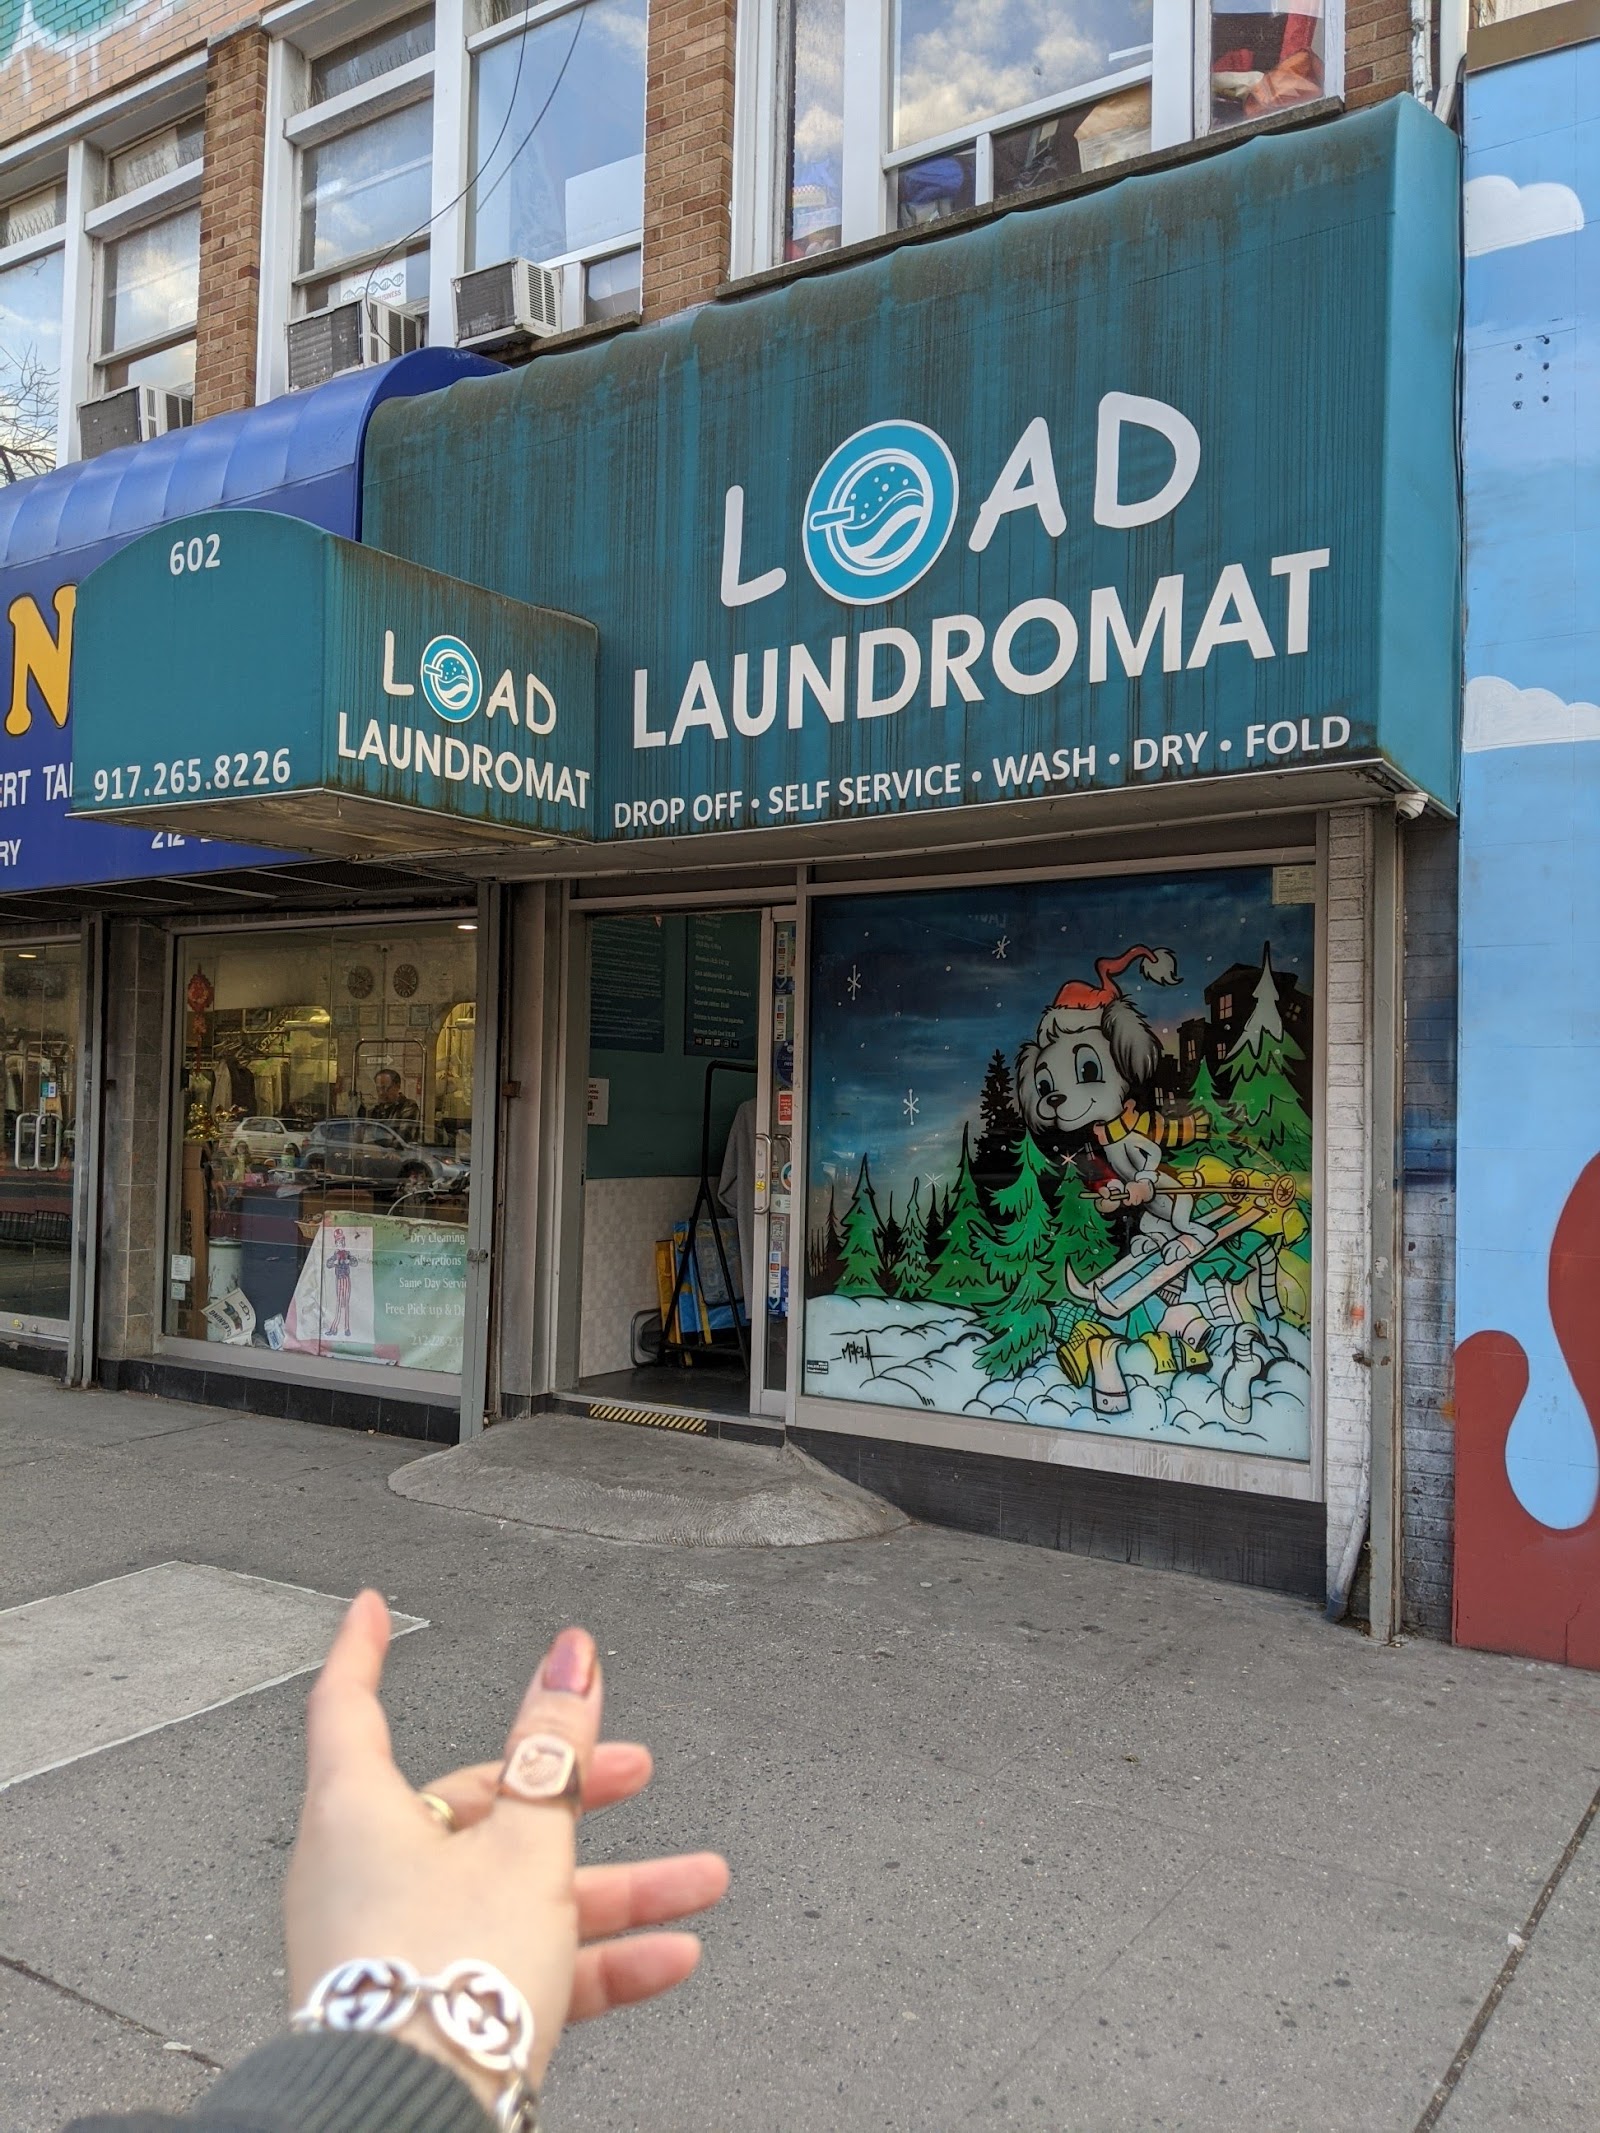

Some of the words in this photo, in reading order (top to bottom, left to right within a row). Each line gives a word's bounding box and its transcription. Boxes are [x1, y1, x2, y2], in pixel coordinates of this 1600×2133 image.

[169, 533, 221, 576] 602
[633, 548, 1330, 750] LAUNDROMAT
[94, 747, 291, 802] 917.265.8226
[338, 711, 591, 809] LAUNDROMAT
[614, 797, 686, 829] DROP
[692, 790, 743, 822] OFF
[768, 780, 830, 815] SELF
[838, 762, 962, 807] SERVICE
[992, 745, 1096, 788] WASH
[1133, 731, 1209, 771] DRY
[1246, 715, 1351, 758] FOLD
[0, 768, 31, 809] RT
[411, 1232, 426, 1245] Dry
[429, 1231, 465, 1245] Cleaning
[413, 1253, 462, 1266] Alterations
[400, 1277, 421, 1289] Same
[424, 1277, 440, 1291] Day
[385, 1302, 405, 1315] Free
[408, 1303, 427, 1316] Pick
[429, 1306, 443, 1318] up
[445, 1304, 453, 1316] &
